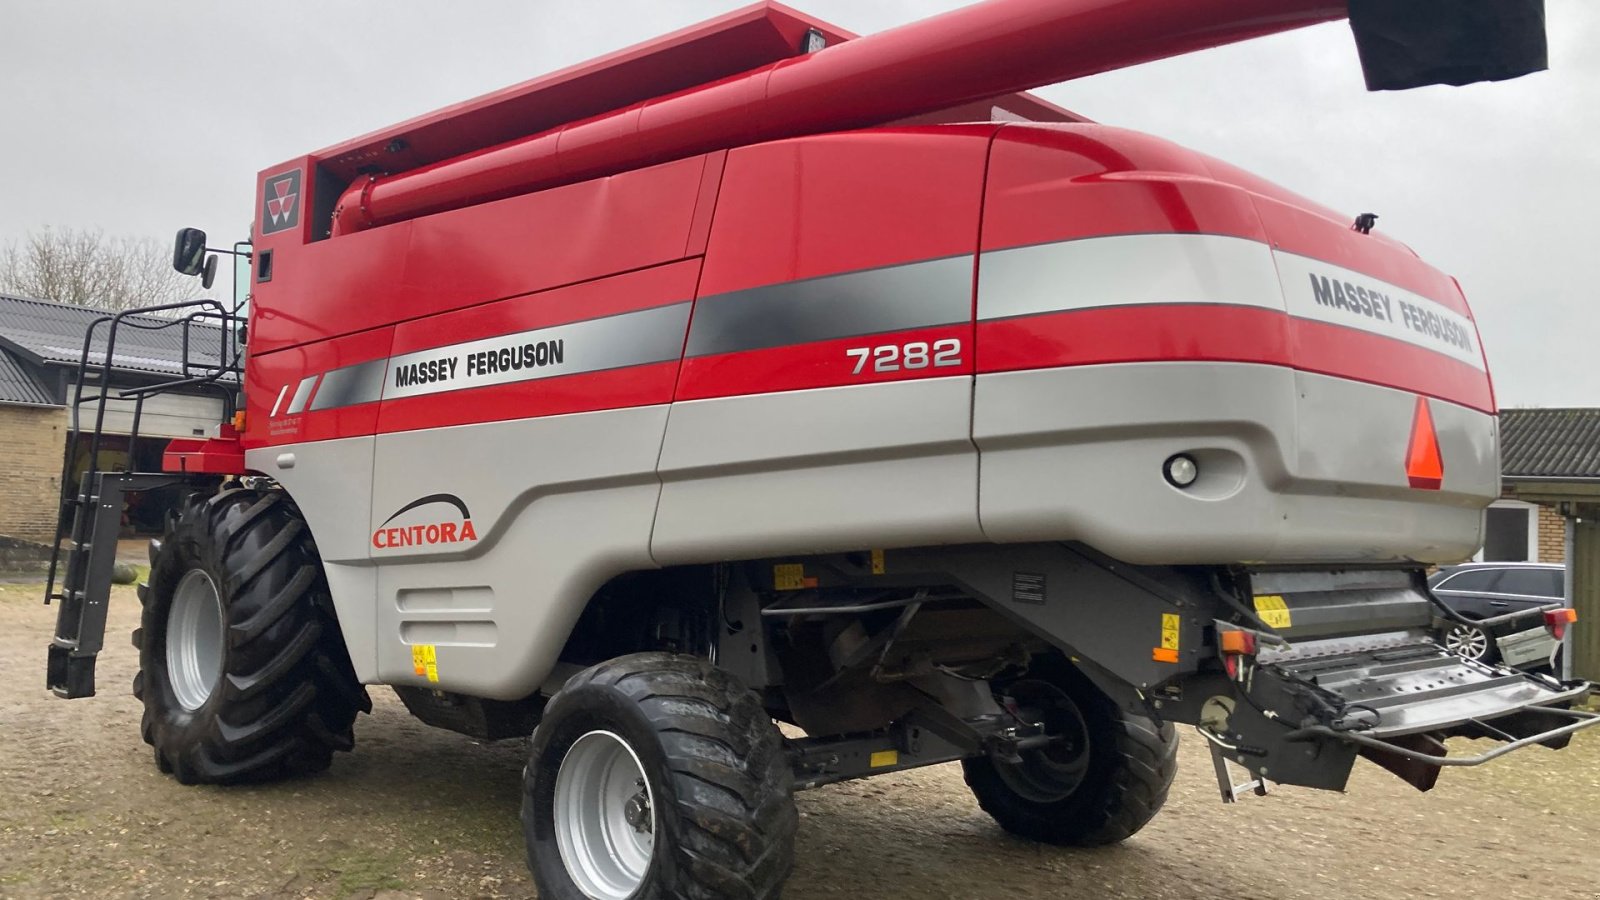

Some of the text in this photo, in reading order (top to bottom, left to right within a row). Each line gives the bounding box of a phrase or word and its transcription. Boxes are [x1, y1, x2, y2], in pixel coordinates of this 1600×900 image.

[1309, 273, 1473, 353] MASSEY FERGUSON
[396, 339, 564, 387] MASSEY FERGUSON
[846, 338, 962, 375] 7282
[372, 520, 478, 549] CENTORA
